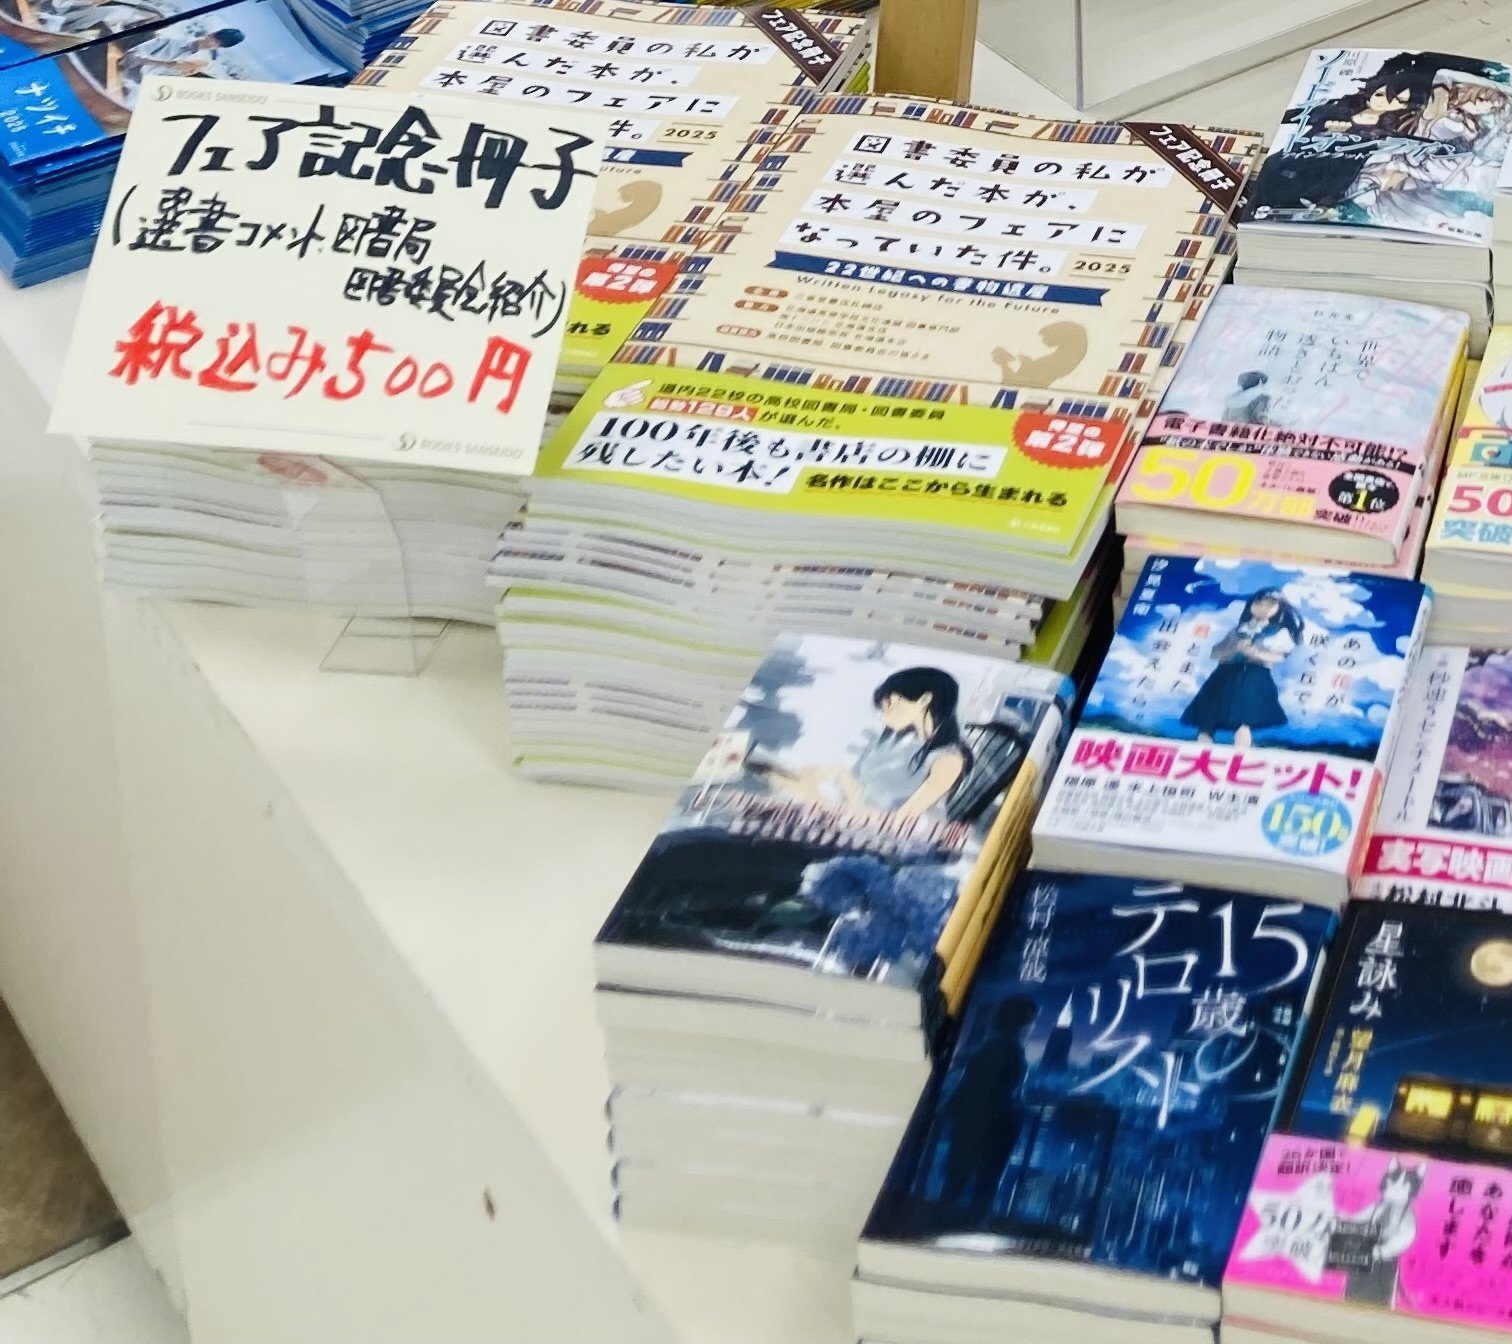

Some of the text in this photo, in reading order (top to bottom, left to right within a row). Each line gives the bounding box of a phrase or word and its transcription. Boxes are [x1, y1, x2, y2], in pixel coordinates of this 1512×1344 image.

[480, 18, 761, 62] 図書委員の私が
[430, 67, 722, 114] 本屋のフェアに
[163, 104, 598, 210] フェア記念冊子
[663, 126, 718, 141] 2025
[851, 133, 1166, 185] 図書委員の私が
[831, 162, 1078, 210] 選んだ本が、
[813, 191, 1128, 245] 本屋のフェアに
[794, 220, 1132, 275] なっていた件。 2025
[109, 301, 532, 416] 税込み500円
[595, 415, 992, 473] 100年後も書店の棚に
[804, 471, 1068, 507] 名作はここから生まれる
[1131, 448, 1254, 509] 50
[1071, 737, 1363, 799] 映画大ヒット!
[1349, 920, 1405, 1021] 星詠み
[1068, 883, 1201, 1129] テロリスト
